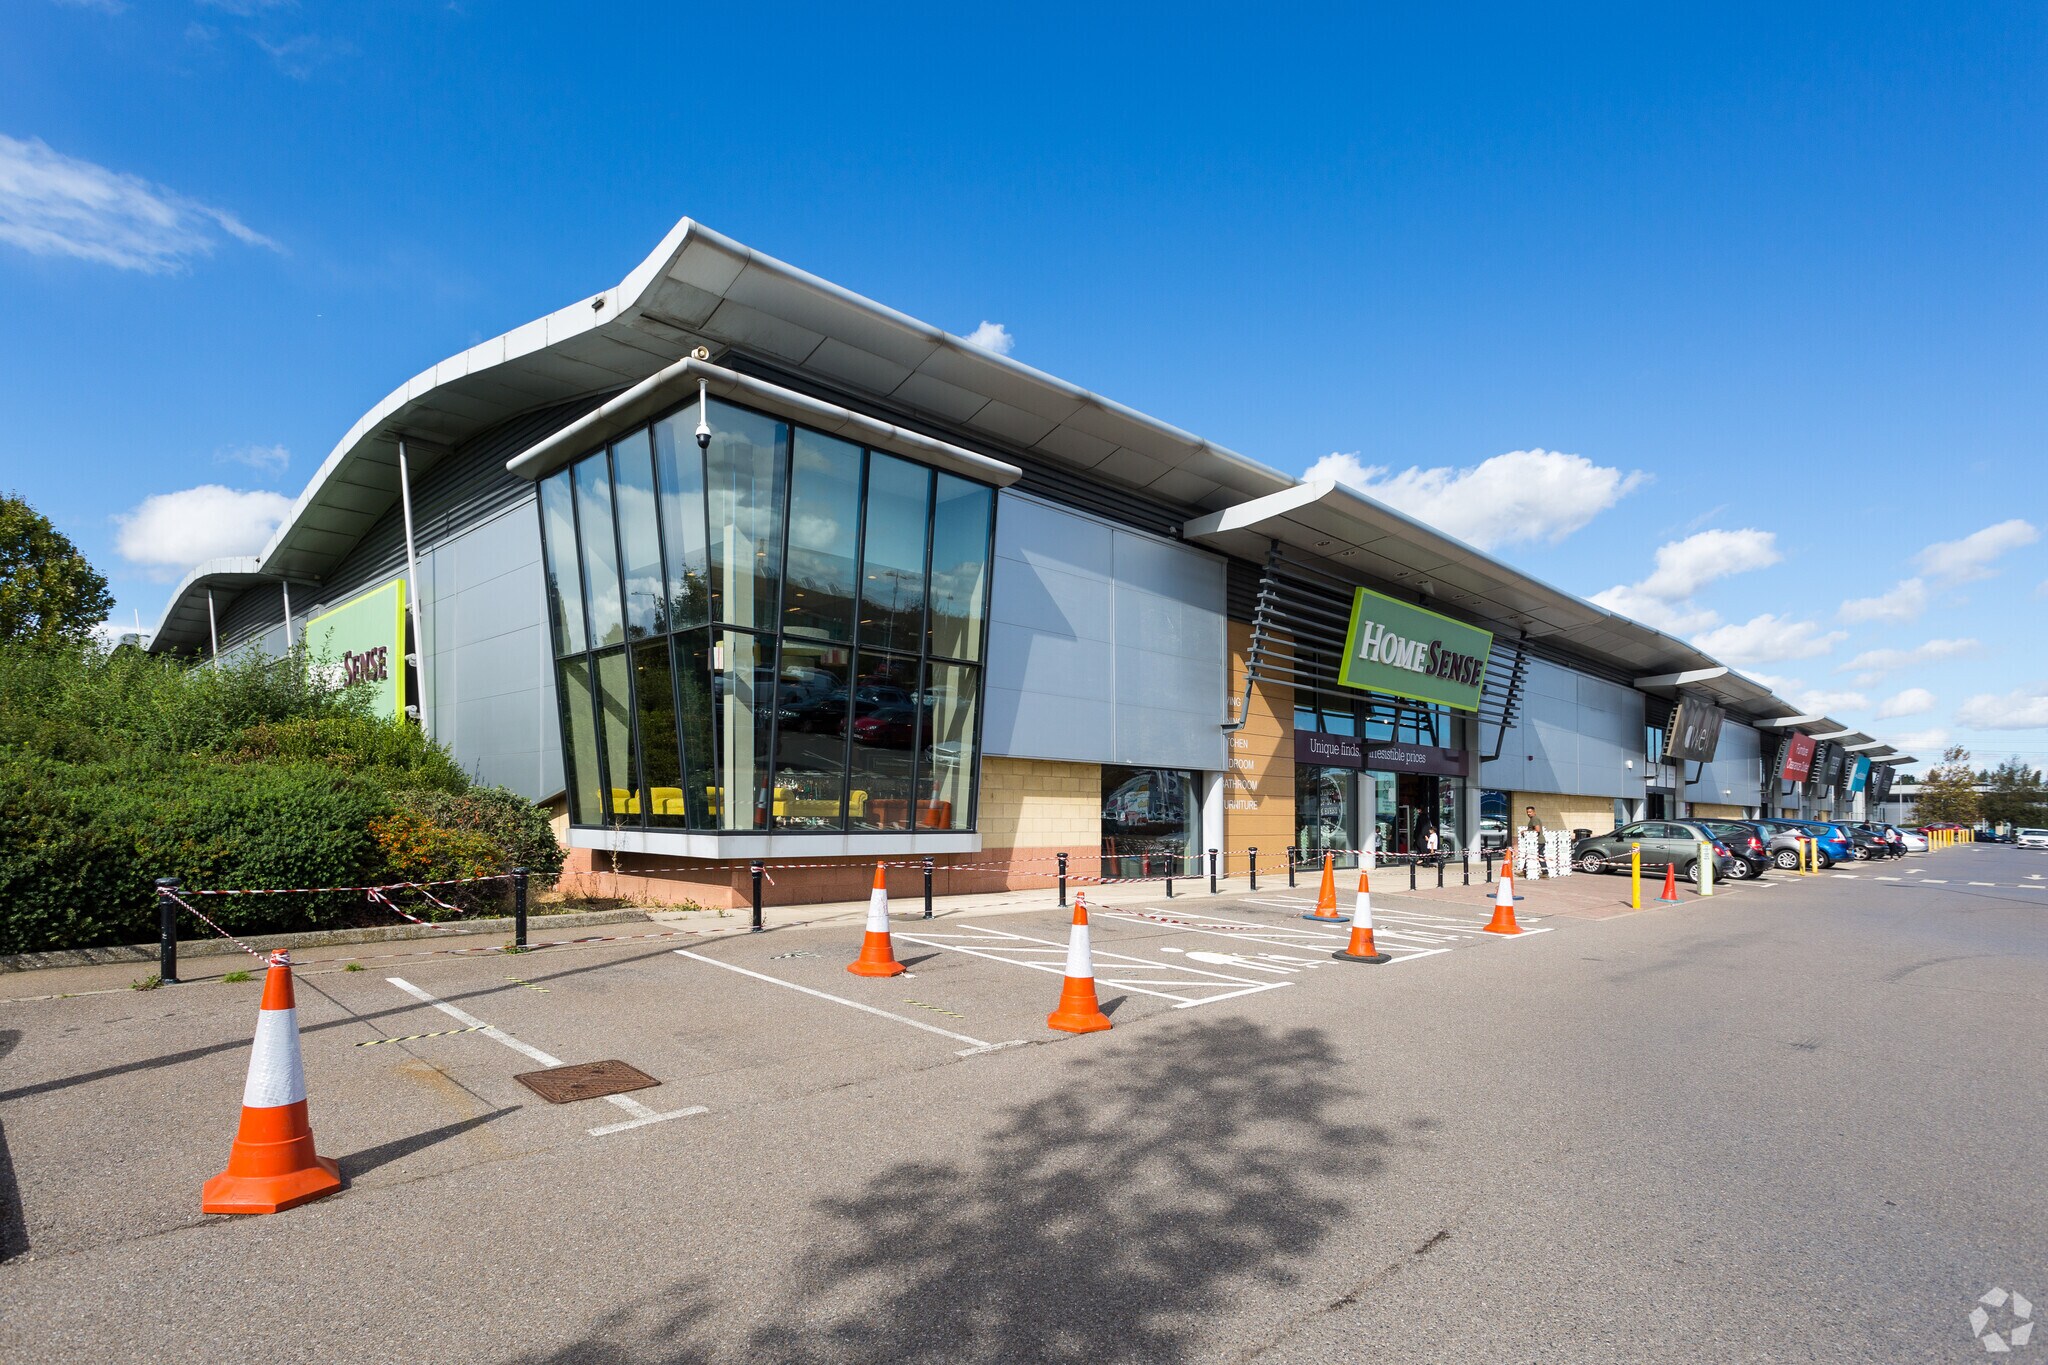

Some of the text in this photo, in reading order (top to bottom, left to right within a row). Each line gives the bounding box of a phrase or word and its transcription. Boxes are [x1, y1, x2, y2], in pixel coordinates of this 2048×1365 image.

[1358, 620, 1484, 687] HOMESENSE
[1310, 738, 1340, 758] Unique
[1406, 750, 1426, 765] prices
[1228, 759, 1255, 769] DROOM
[1223, 779, 1258, 791] ATHROOM
[1224, 800, 1258, 810] URNITURE
